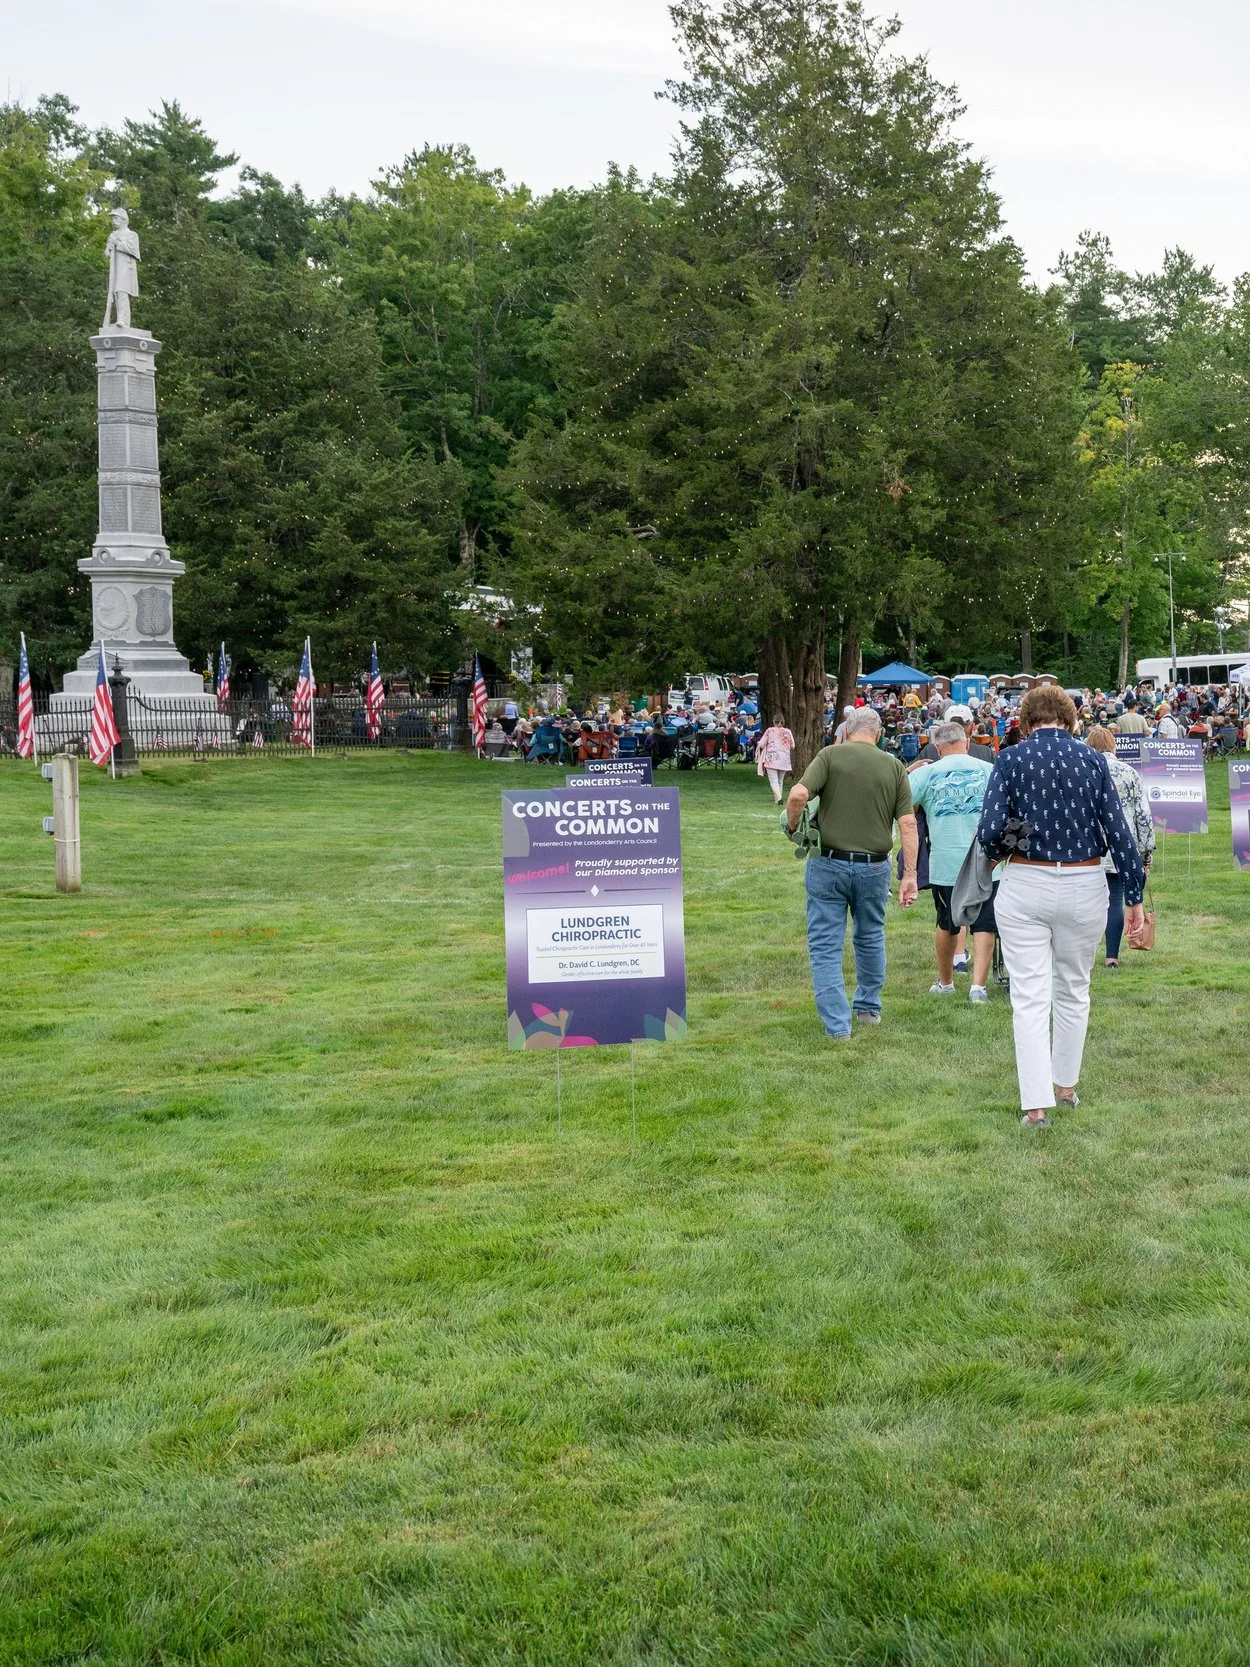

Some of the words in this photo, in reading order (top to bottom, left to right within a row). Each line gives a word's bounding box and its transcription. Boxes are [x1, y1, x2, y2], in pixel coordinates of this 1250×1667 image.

[589, 762, 634, 771] CONCERTS
[570, 778, 621, 787] CONCERTS
[1162, 790, 1188, 798] Spindel
[1190, 790, 1201, 798] Eye
[512, 799, 633, 818] CONCERTS
[635, 803, 649, 811] ON
[651, 802, 670, 811] THE
[555, 817, 660, 836] COMMON
[564, 840, 573, 848] by
[584, 839, 623, 847] Londonderry
[575, 858, 613, 869] Proudly
[614, 857, 665, 868] supported
[666, 857, 679, 867] by
[508, 862, 570, 886] Welcome!
[575, 869, 591, 877] our
[594, 867, 638, 877] Diamond
[640, 866, 680, 876] Sponsor
[561, 915, 630, 929] LUNDGREN
[551, 928, 642, 943] CHIROPRACTIC
[589, 960, 597, 968] C.
[598, 960, 630, 969] Lundgren,
